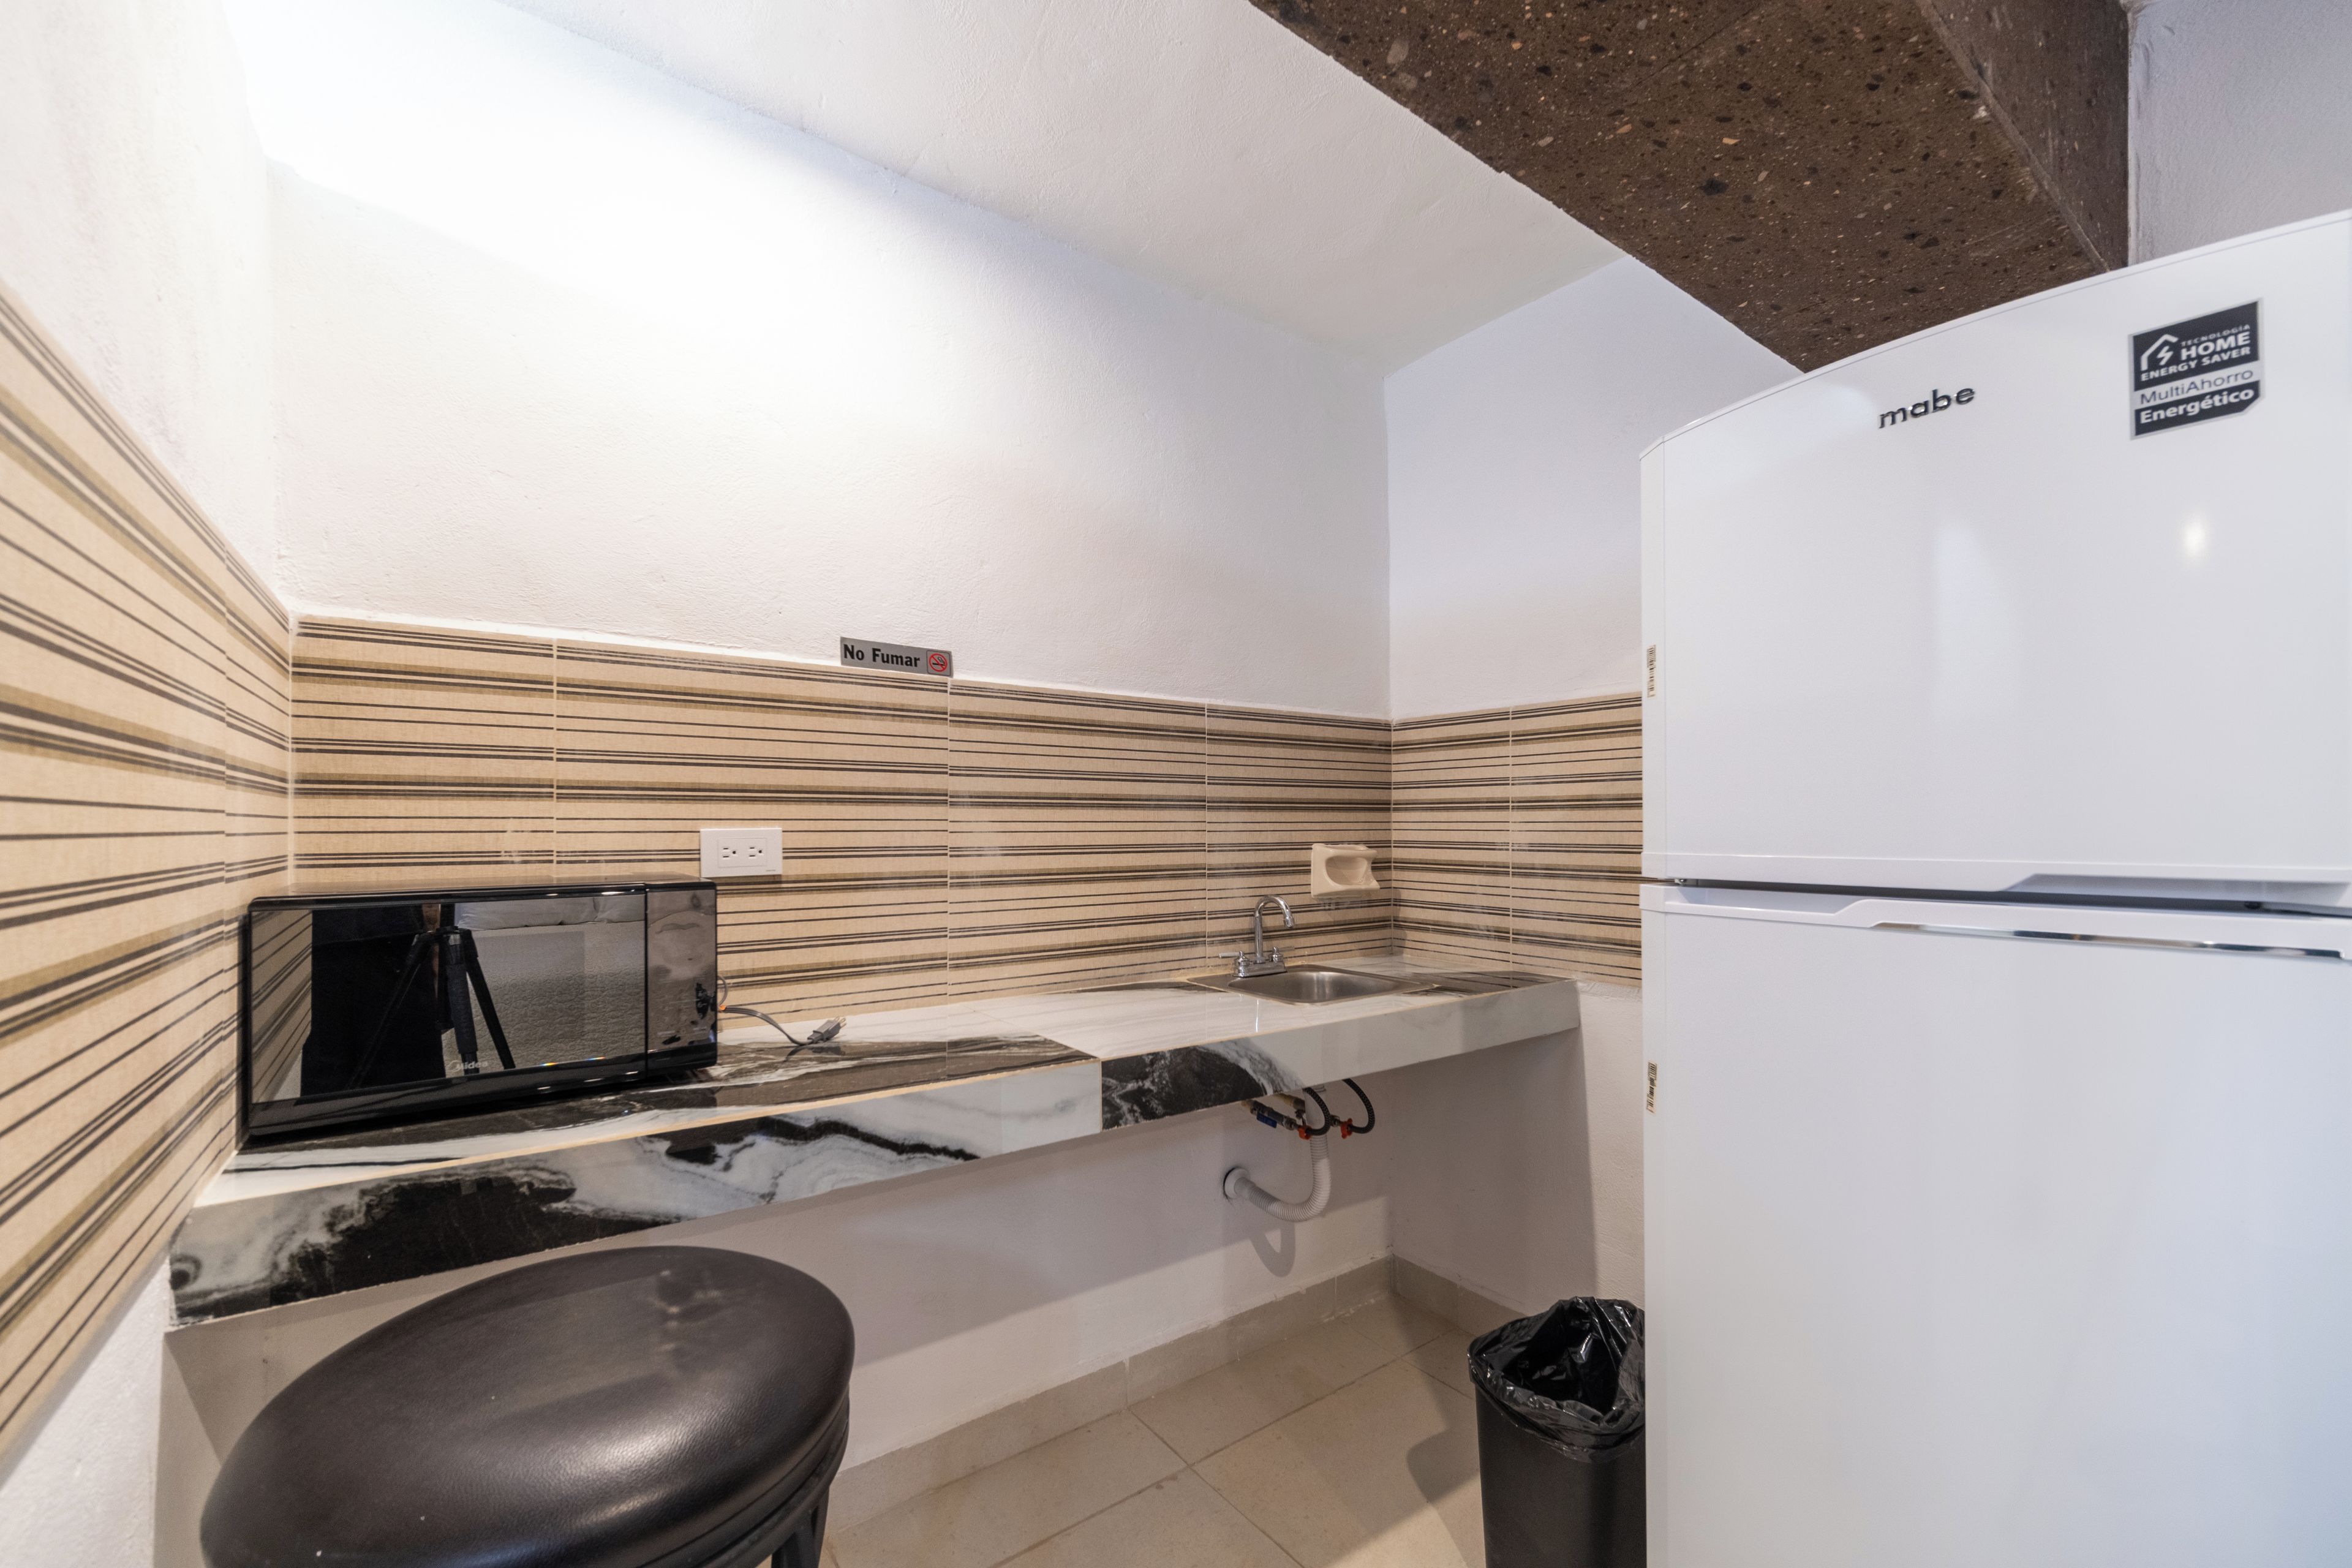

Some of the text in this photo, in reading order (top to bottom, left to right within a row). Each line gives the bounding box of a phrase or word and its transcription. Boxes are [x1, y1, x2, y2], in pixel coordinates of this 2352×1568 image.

[2180, 331, 2251, 360] HOME
[2141, 346, 2251, 381] ENERGY SAVER
[2140, 369, 2253, 405] MultiAhorro
[1879, 388, 1975, 429] mabe
[2139, 389, 2255, 424] Energético
[843, 644, 921, 668] No Fumar
